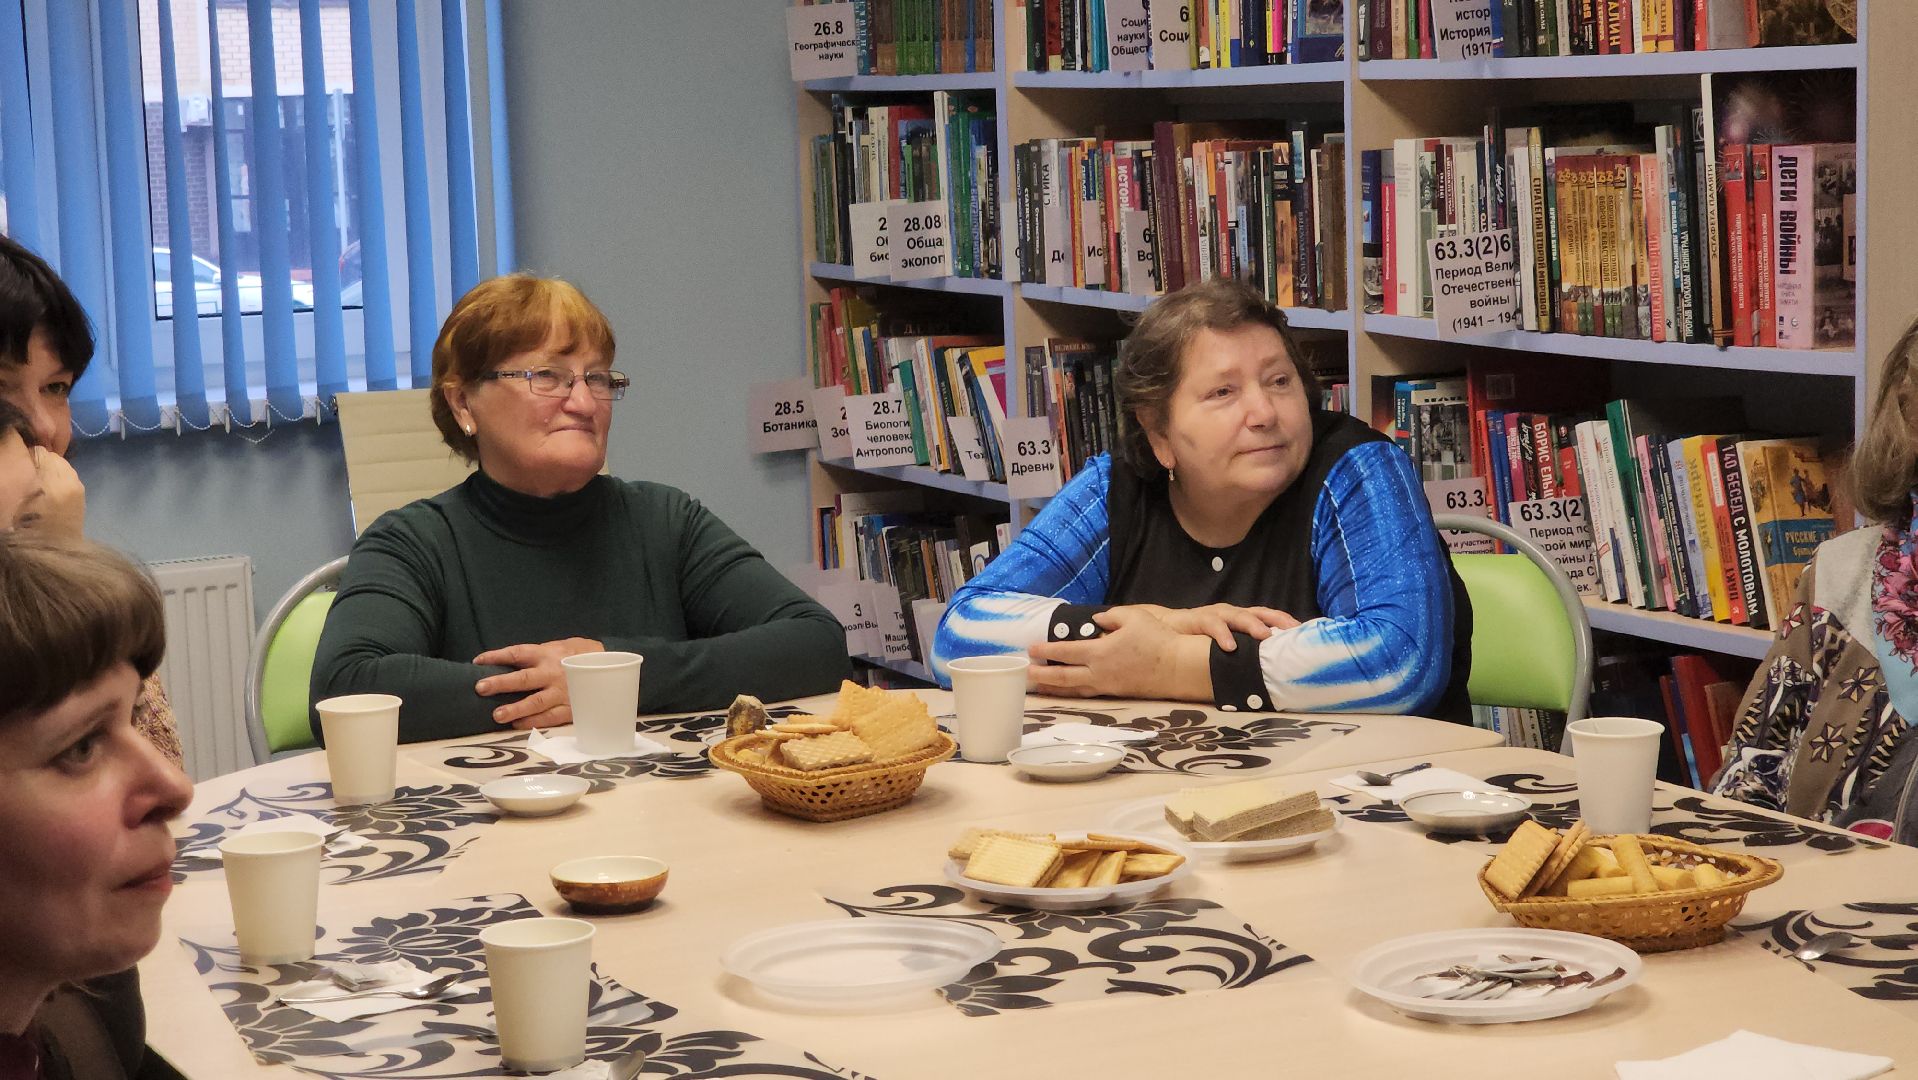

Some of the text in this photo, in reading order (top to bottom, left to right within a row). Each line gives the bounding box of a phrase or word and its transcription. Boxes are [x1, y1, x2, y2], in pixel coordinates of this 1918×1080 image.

[814, 21, 844, 36] 26.8
[1121, 18, 1147, 27] Соци
[1117, 32, 1145, 43] науки
[1440, 26, 1491, 41] История
[819, 52, 844, 61] науки
[1533, 177, 1543, 230] СТРАТЕГИЯ
[1707, 164, 1718, 259] ЭСТАФЕТА ПАМЯТИ
[878, 218, 887, 231] 2
[904, 215, 942, 232] 28.08
[906, 237, 944, 249] Обща
[1435, 234, 1511, 260] 63.3(2)6
[1535, 231, 1545, 269] ВТОРОЙ
[1436, 266, 1482, 280] Период
[1537, 271, 1547, 317] МИРОВОЙ
[1682, 274, 1691, 308] БЛОКАДЫ
[1470, 295, 1510, 308] войны
[1453, 316, 1483, 333] (1941
[1684, 310, 1693, 337] ПРОРЫВ
[774, 401, 804, 415] 28.5
[873, 400, 902, 415] 28.7
[763, 418, 818, 433] Ботаника
[1017, 440, 1050, 456] 63.3
[1534, 422, 1549, 463] БОРИС
[856, 446, 913, 458] Антрополо
[1721, 445, 1735, 469] 140
[1727, 472, 1743, 515] БЕСЕД
[1733, 516, 1746, 526] С
[1530, 526, 1574, 539] Период
[1541, 540, 1566, 551] рой
[1736, 529, 1759, 615] МОЛОТОВЫМ
[853, 603, 862, 617] 3
